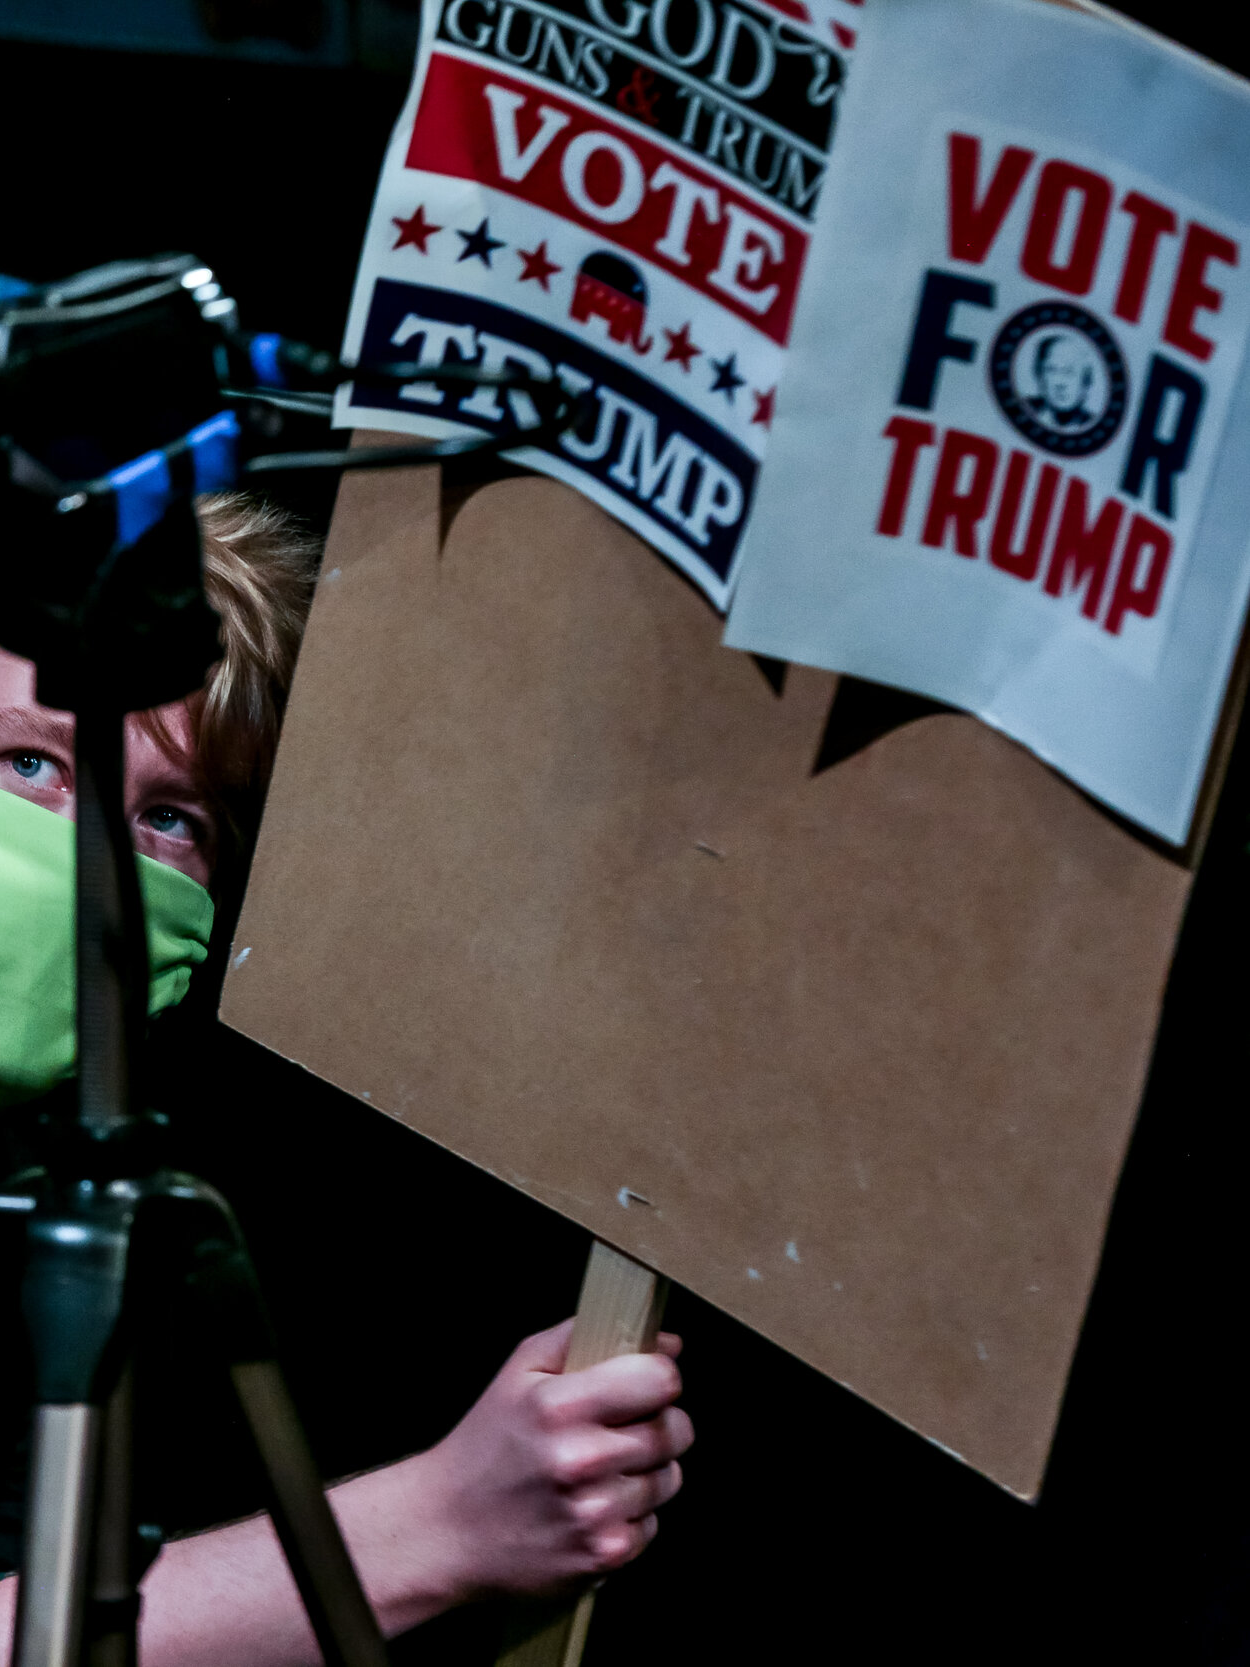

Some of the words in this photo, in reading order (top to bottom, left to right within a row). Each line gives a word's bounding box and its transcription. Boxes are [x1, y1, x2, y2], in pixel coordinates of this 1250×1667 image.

[444, 0, 615, 98] GUNS
[615, 66, 662, 127] &
[481, 82, 786, 315] VOTE
[947, 131, 1240, 363] VOTE
[390, 312, 744, 546] TRUMP
[895, 267, 1206, 520] FOR
[876, 415, 1175, 637] TRUMP
